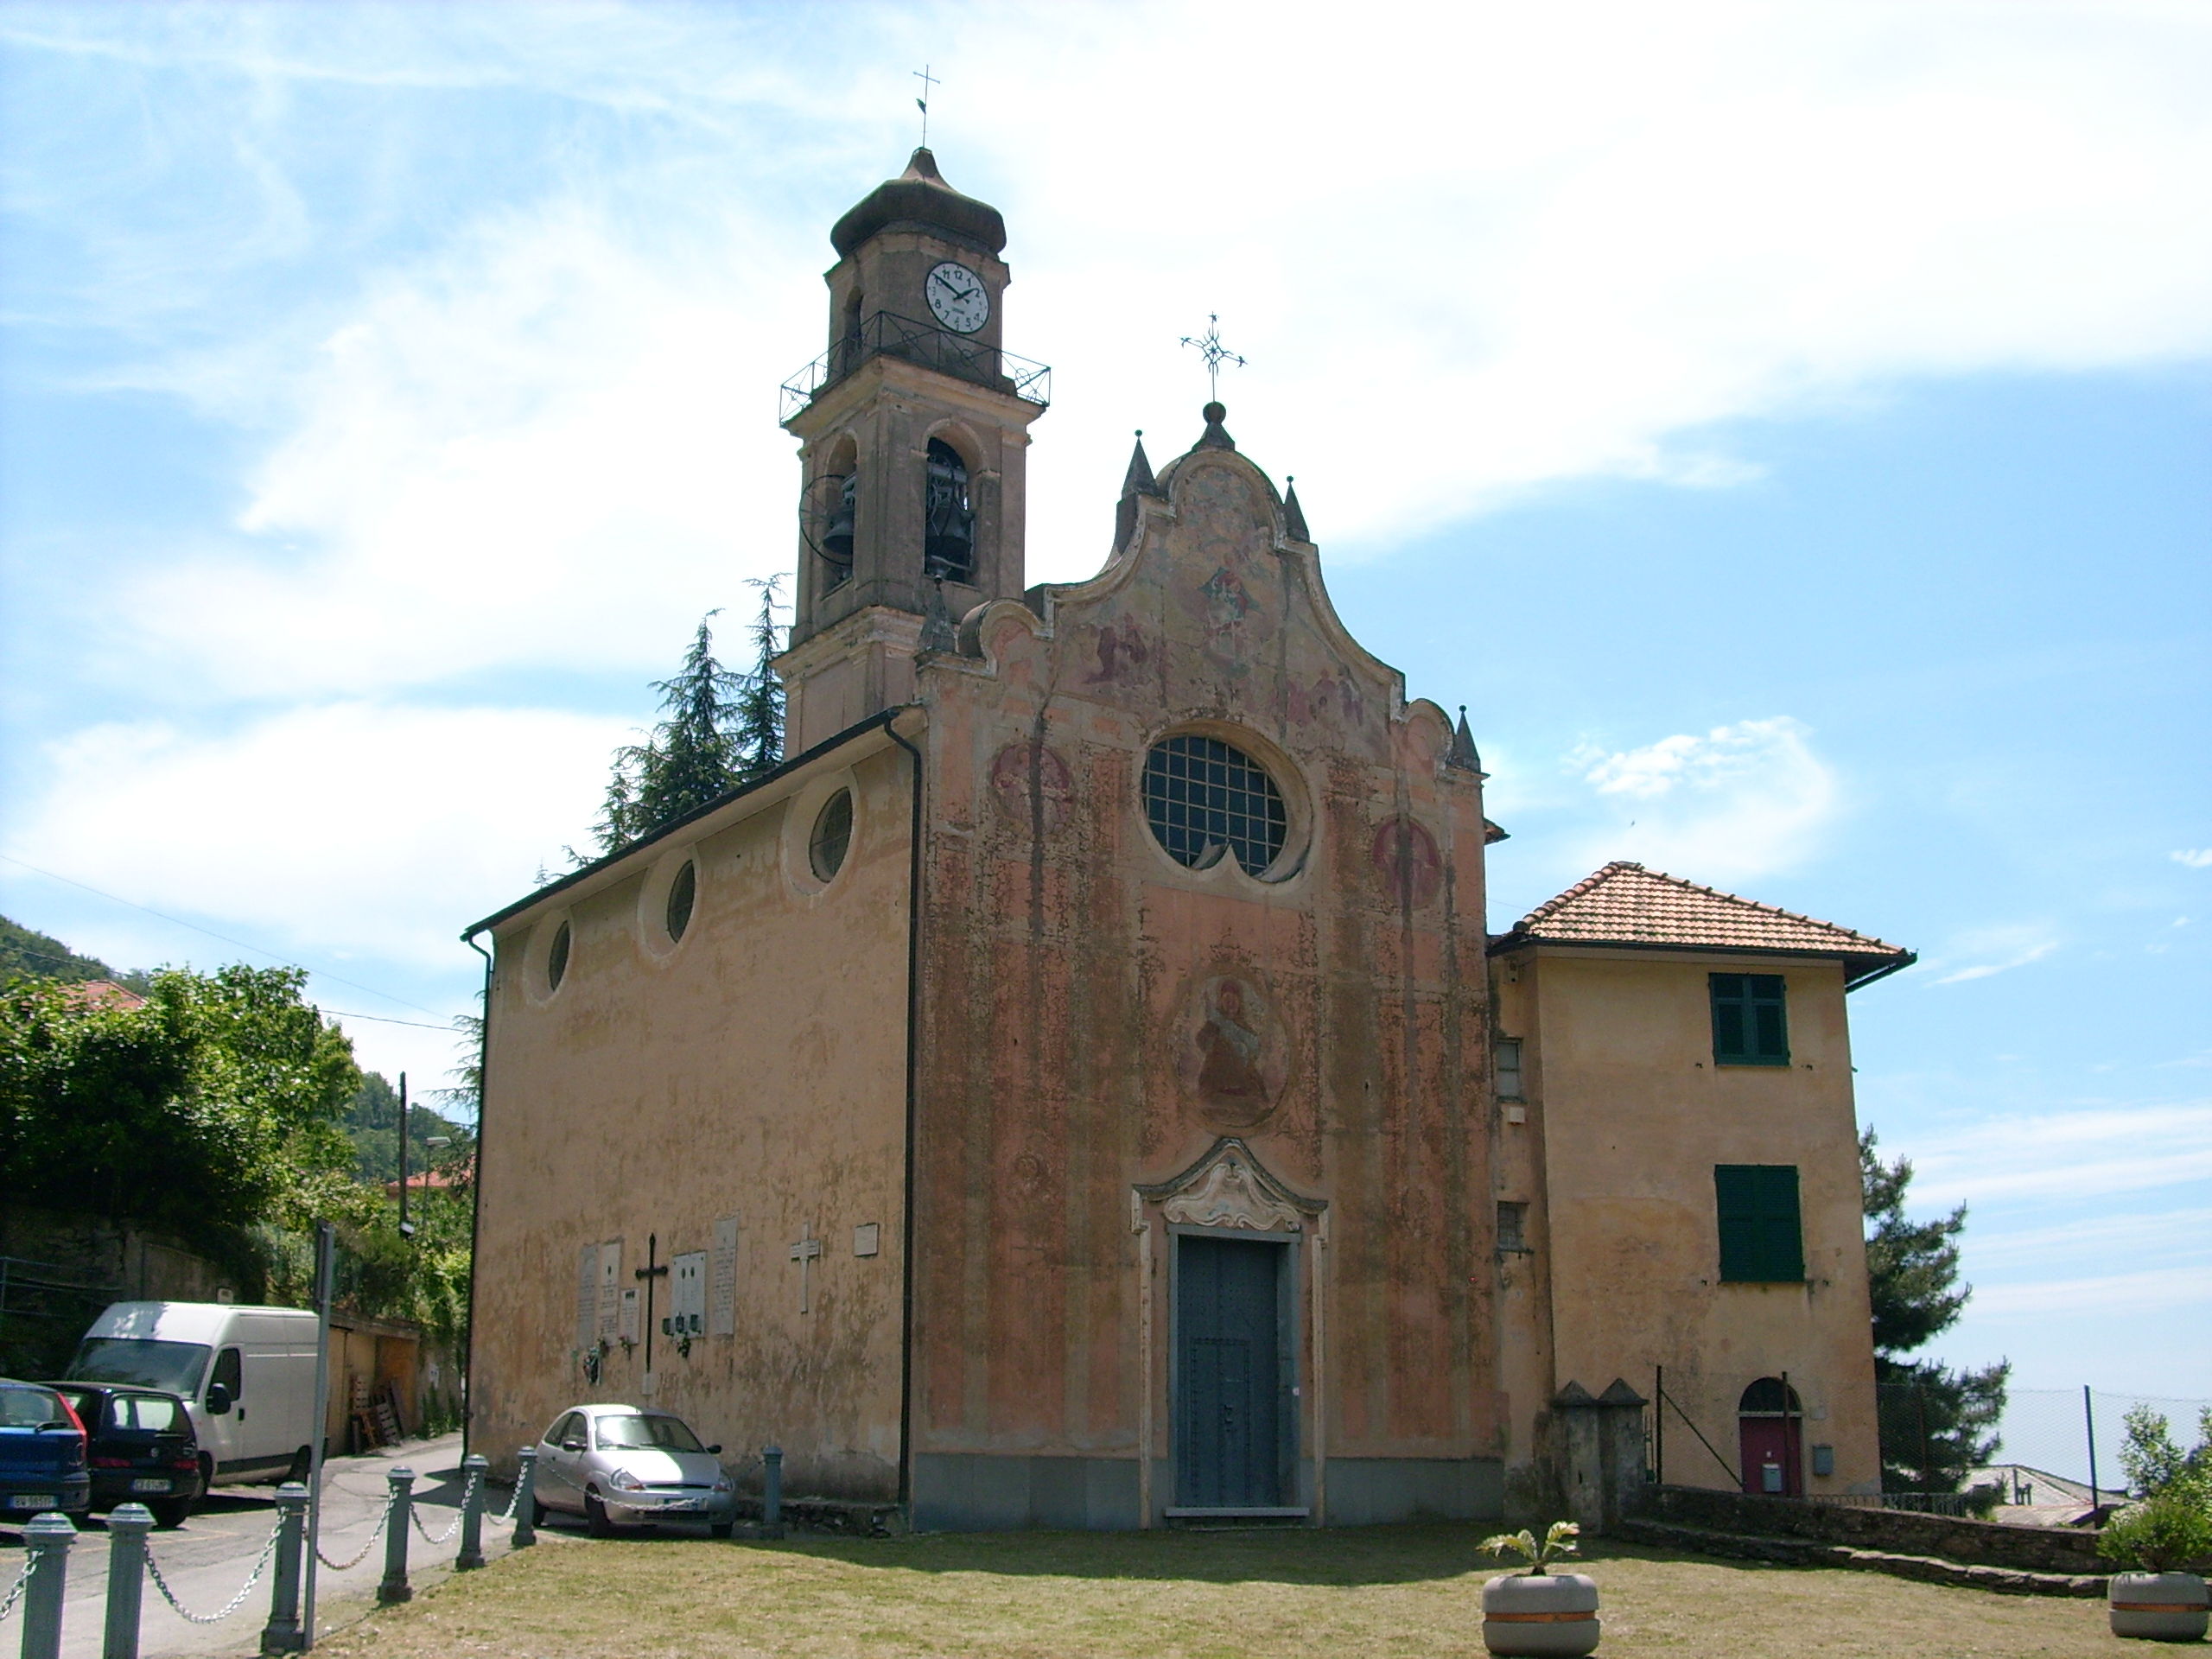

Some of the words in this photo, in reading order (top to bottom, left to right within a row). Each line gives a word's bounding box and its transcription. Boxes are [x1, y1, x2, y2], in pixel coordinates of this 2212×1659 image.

[954, 270, 963, 281] 12
[967, 277, 971, 287] 1
[934, 299, 941, 308] 8
[944, 310, 950, 320] 7
[966, 317, 971, 327] 5
